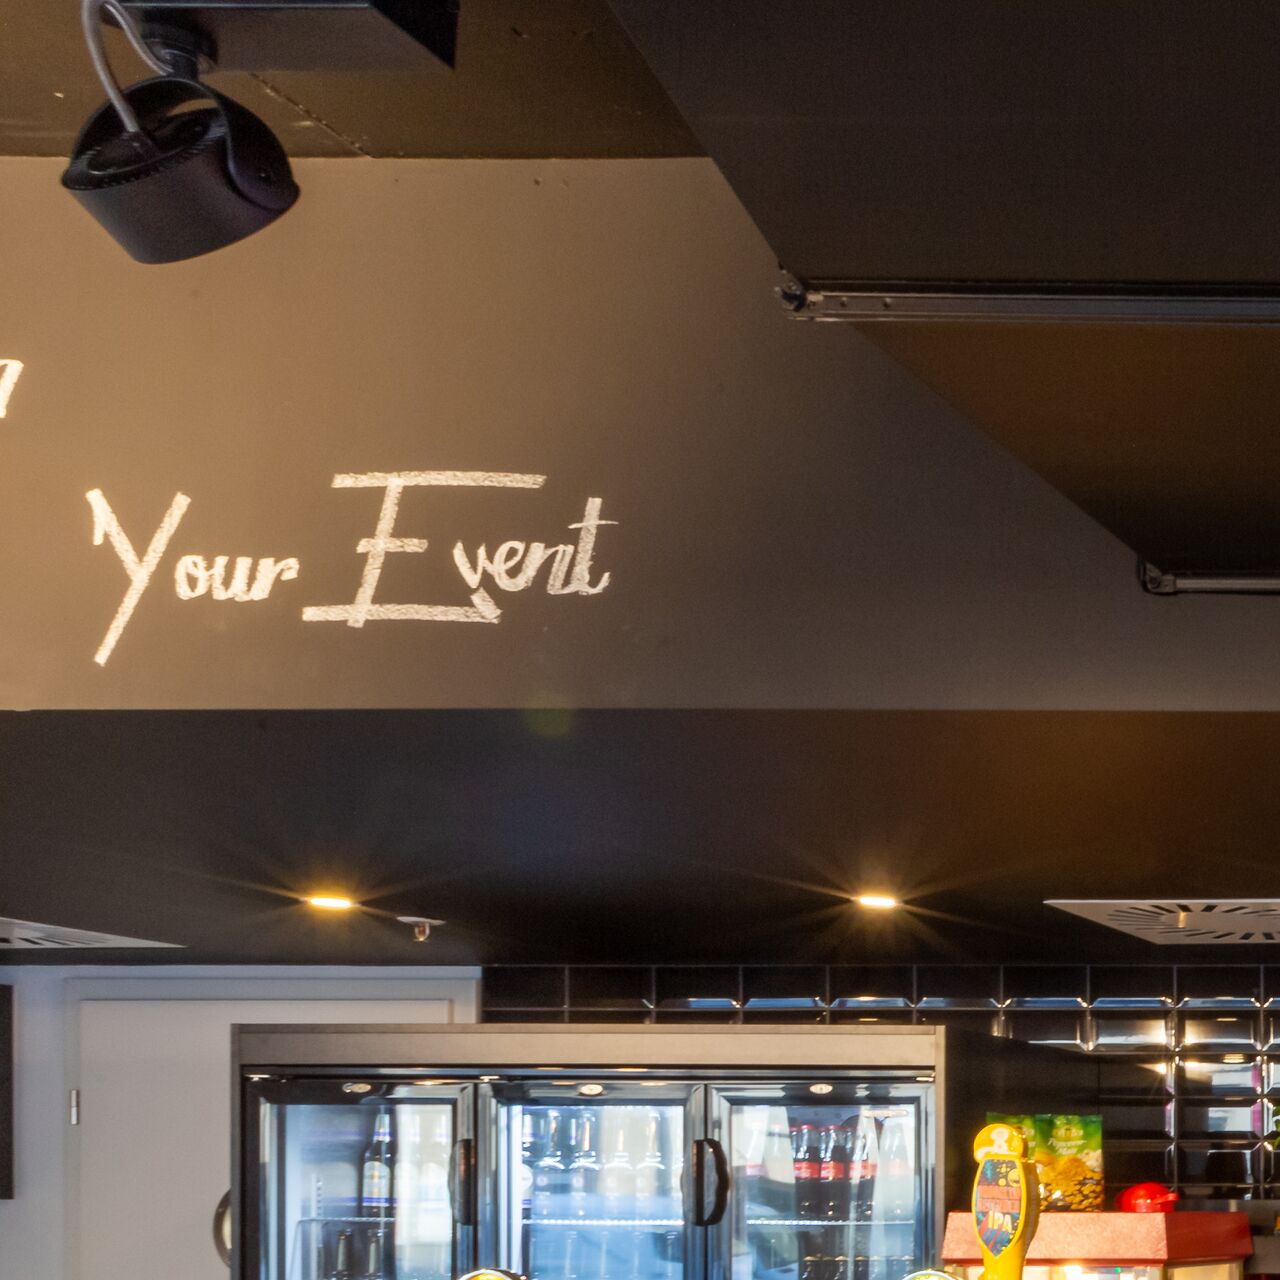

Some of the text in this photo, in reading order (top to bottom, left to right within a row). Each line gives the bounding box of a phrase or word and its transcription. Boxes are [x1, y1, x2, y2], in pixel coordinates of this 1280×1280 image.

[86, 470, 619, 667] Your Event
[988, 1209, 1013, 1232] IPA
